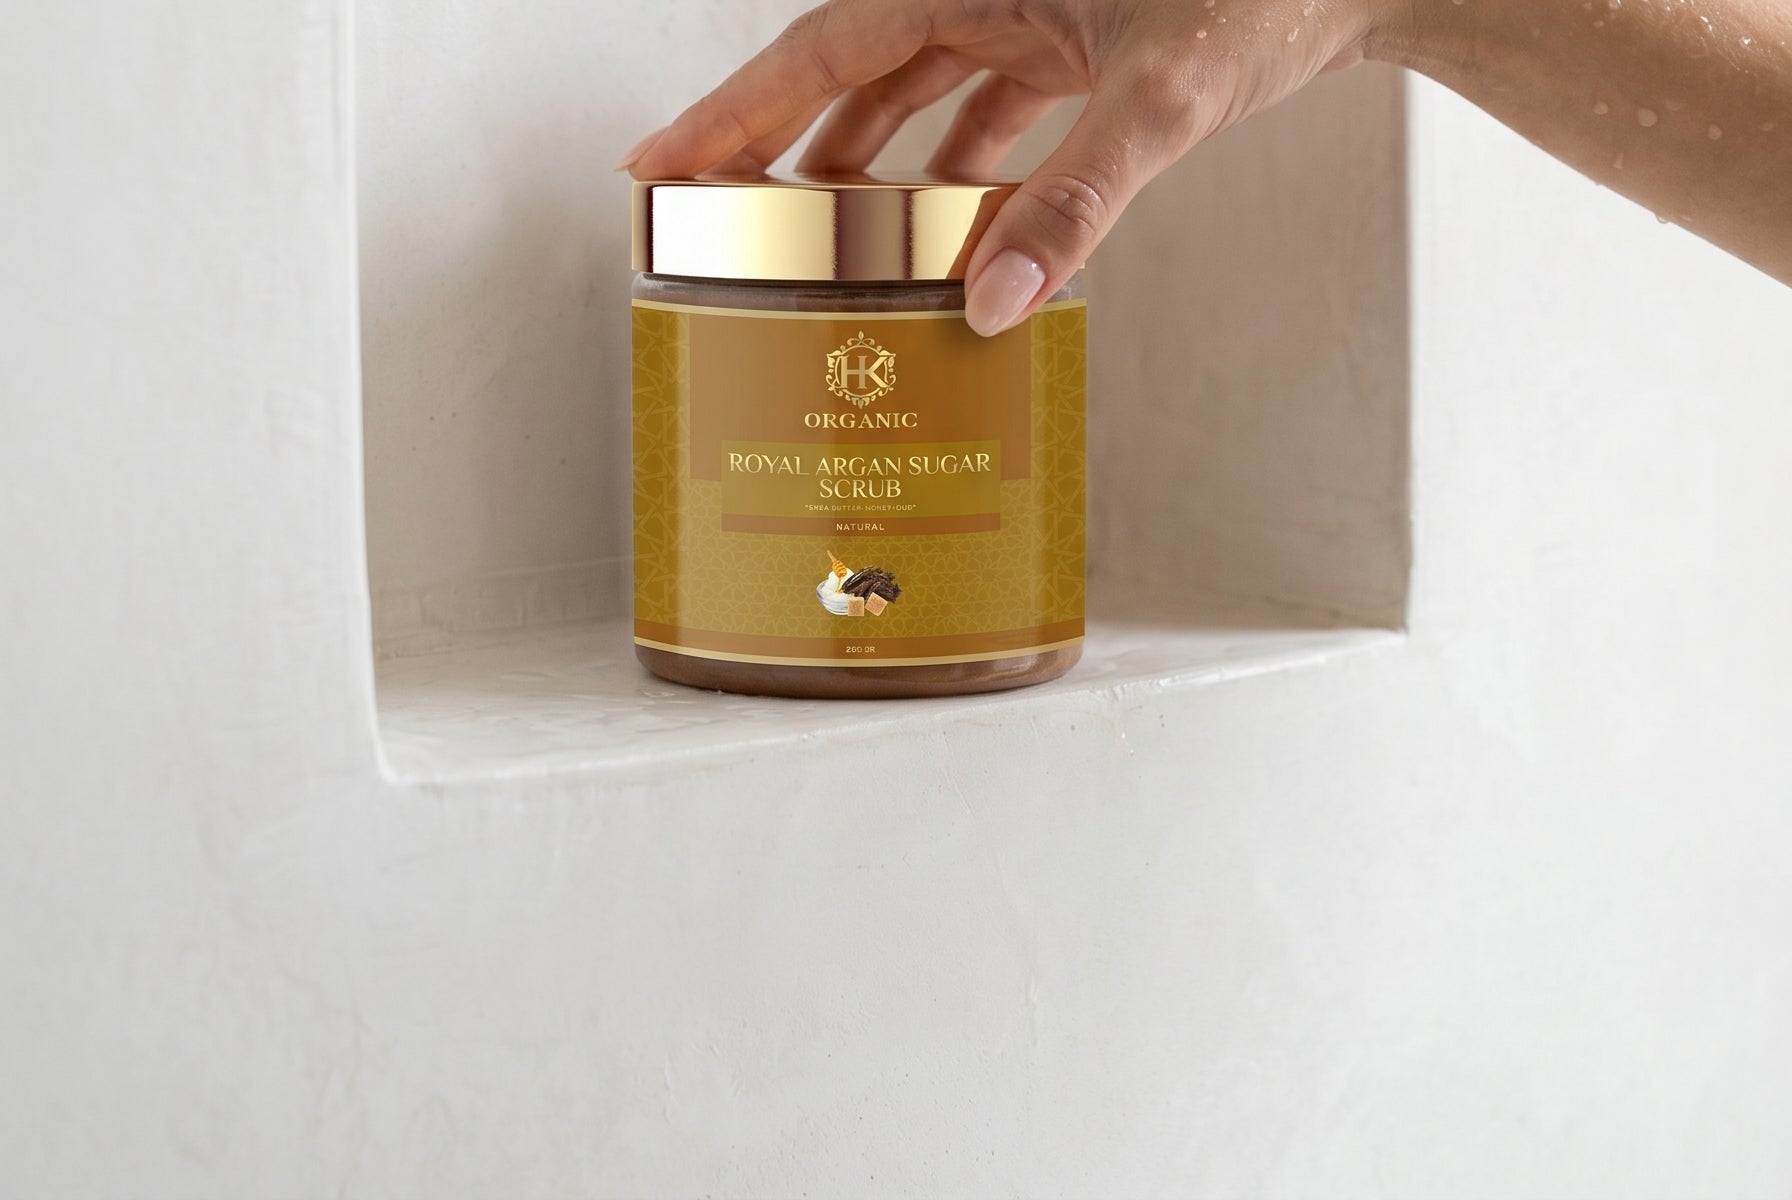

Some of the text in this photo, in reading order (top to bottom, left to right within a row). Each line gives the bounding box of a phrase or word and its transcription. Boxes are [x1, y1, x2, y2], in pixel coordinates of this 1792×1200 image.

[804, 412, 918, 429] ORGANIC
[728, 452, 991, 476] ROYAL ARGAN SUGAR
[819, 478, 901, 499] SCRUB
[836, 523, 885, 531] NATURAL
